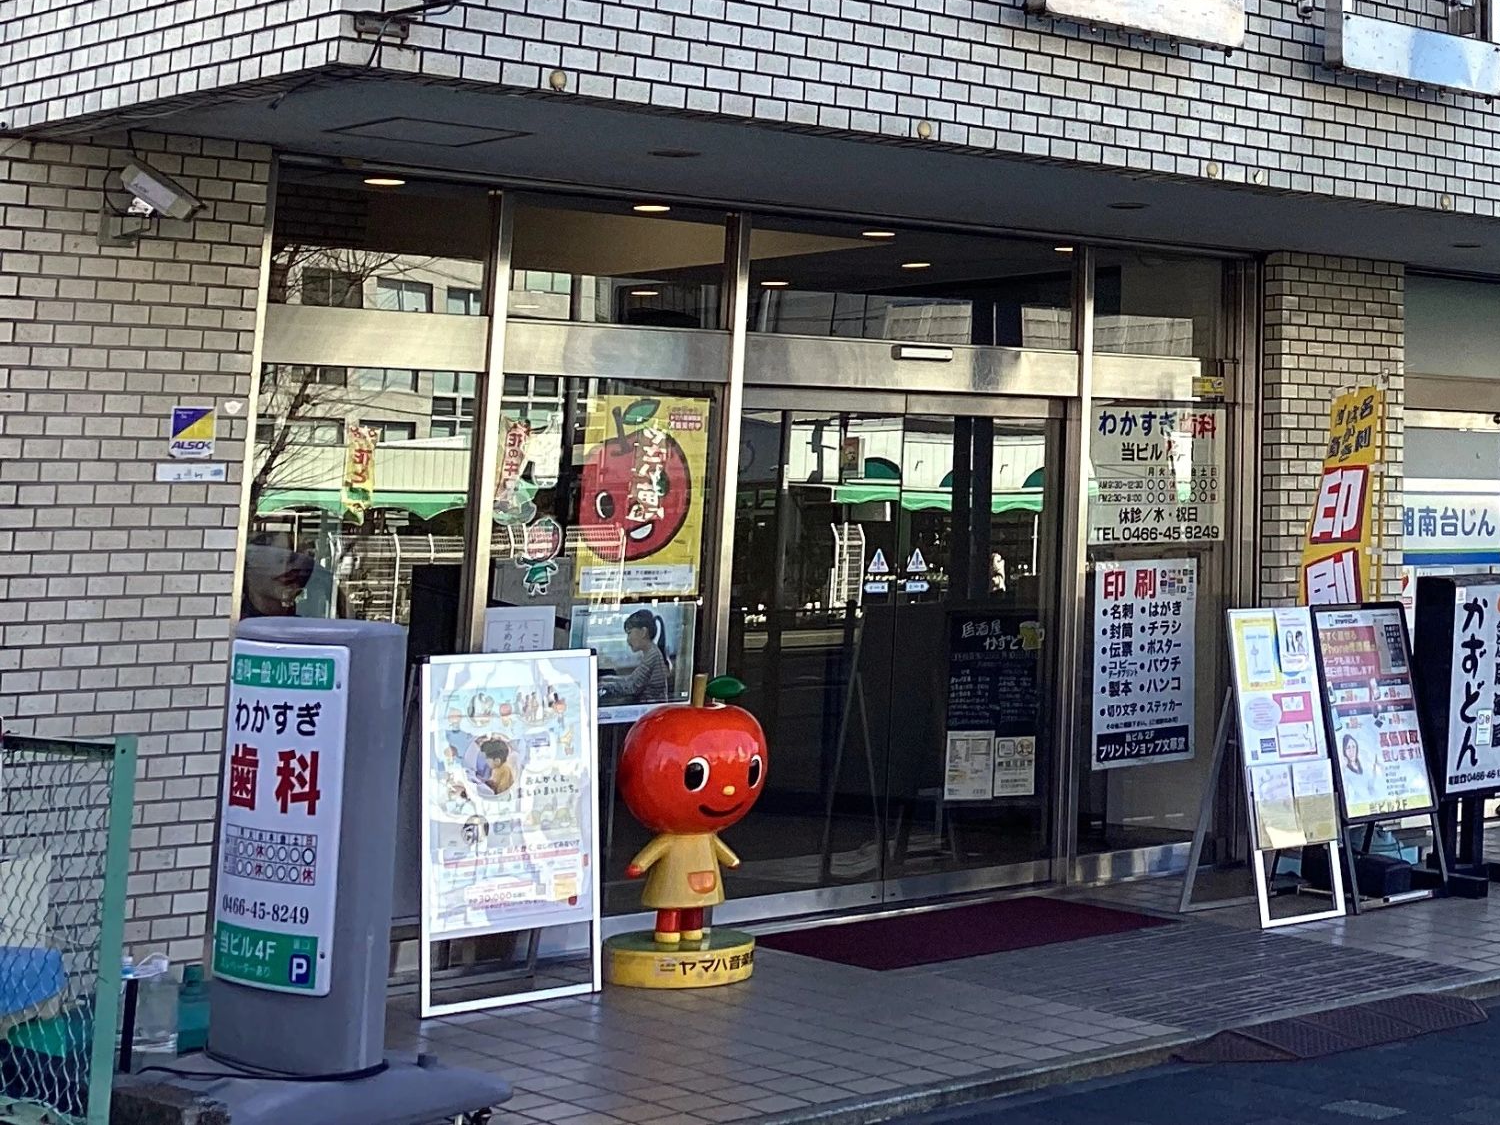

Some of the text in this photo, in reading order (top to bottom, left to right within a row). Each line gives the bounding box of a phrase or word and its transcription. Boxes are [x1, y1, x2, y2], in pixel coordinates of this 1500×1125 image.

[171, 441, 212, 450] ALSOK
[1103, 568, 1157, 602] 印刷
[1110, 601, 1182, 620] 名刺 はがき
[1109, 620, 1182, 639] 封筒 チラシ
[1109, 638, 1182, 658] 伝票 ポスター
[1108, 660, 1138, 670] コピー
[1108, 677, 1181, 697] 製本 ハンコ
[1456, 597, 1488, 771] かずどん
[235, 698, 322, 736] わかすぎ
[1107, 699, 1183, 717] 切り文字 ステッカー
[227, 743, 322, 817] 歯科
[222, 893, 310, 925] 0466-45-8249
[291, 957, 308, 982] P
[678, 950, 754, 976] ヤマハ音楽
